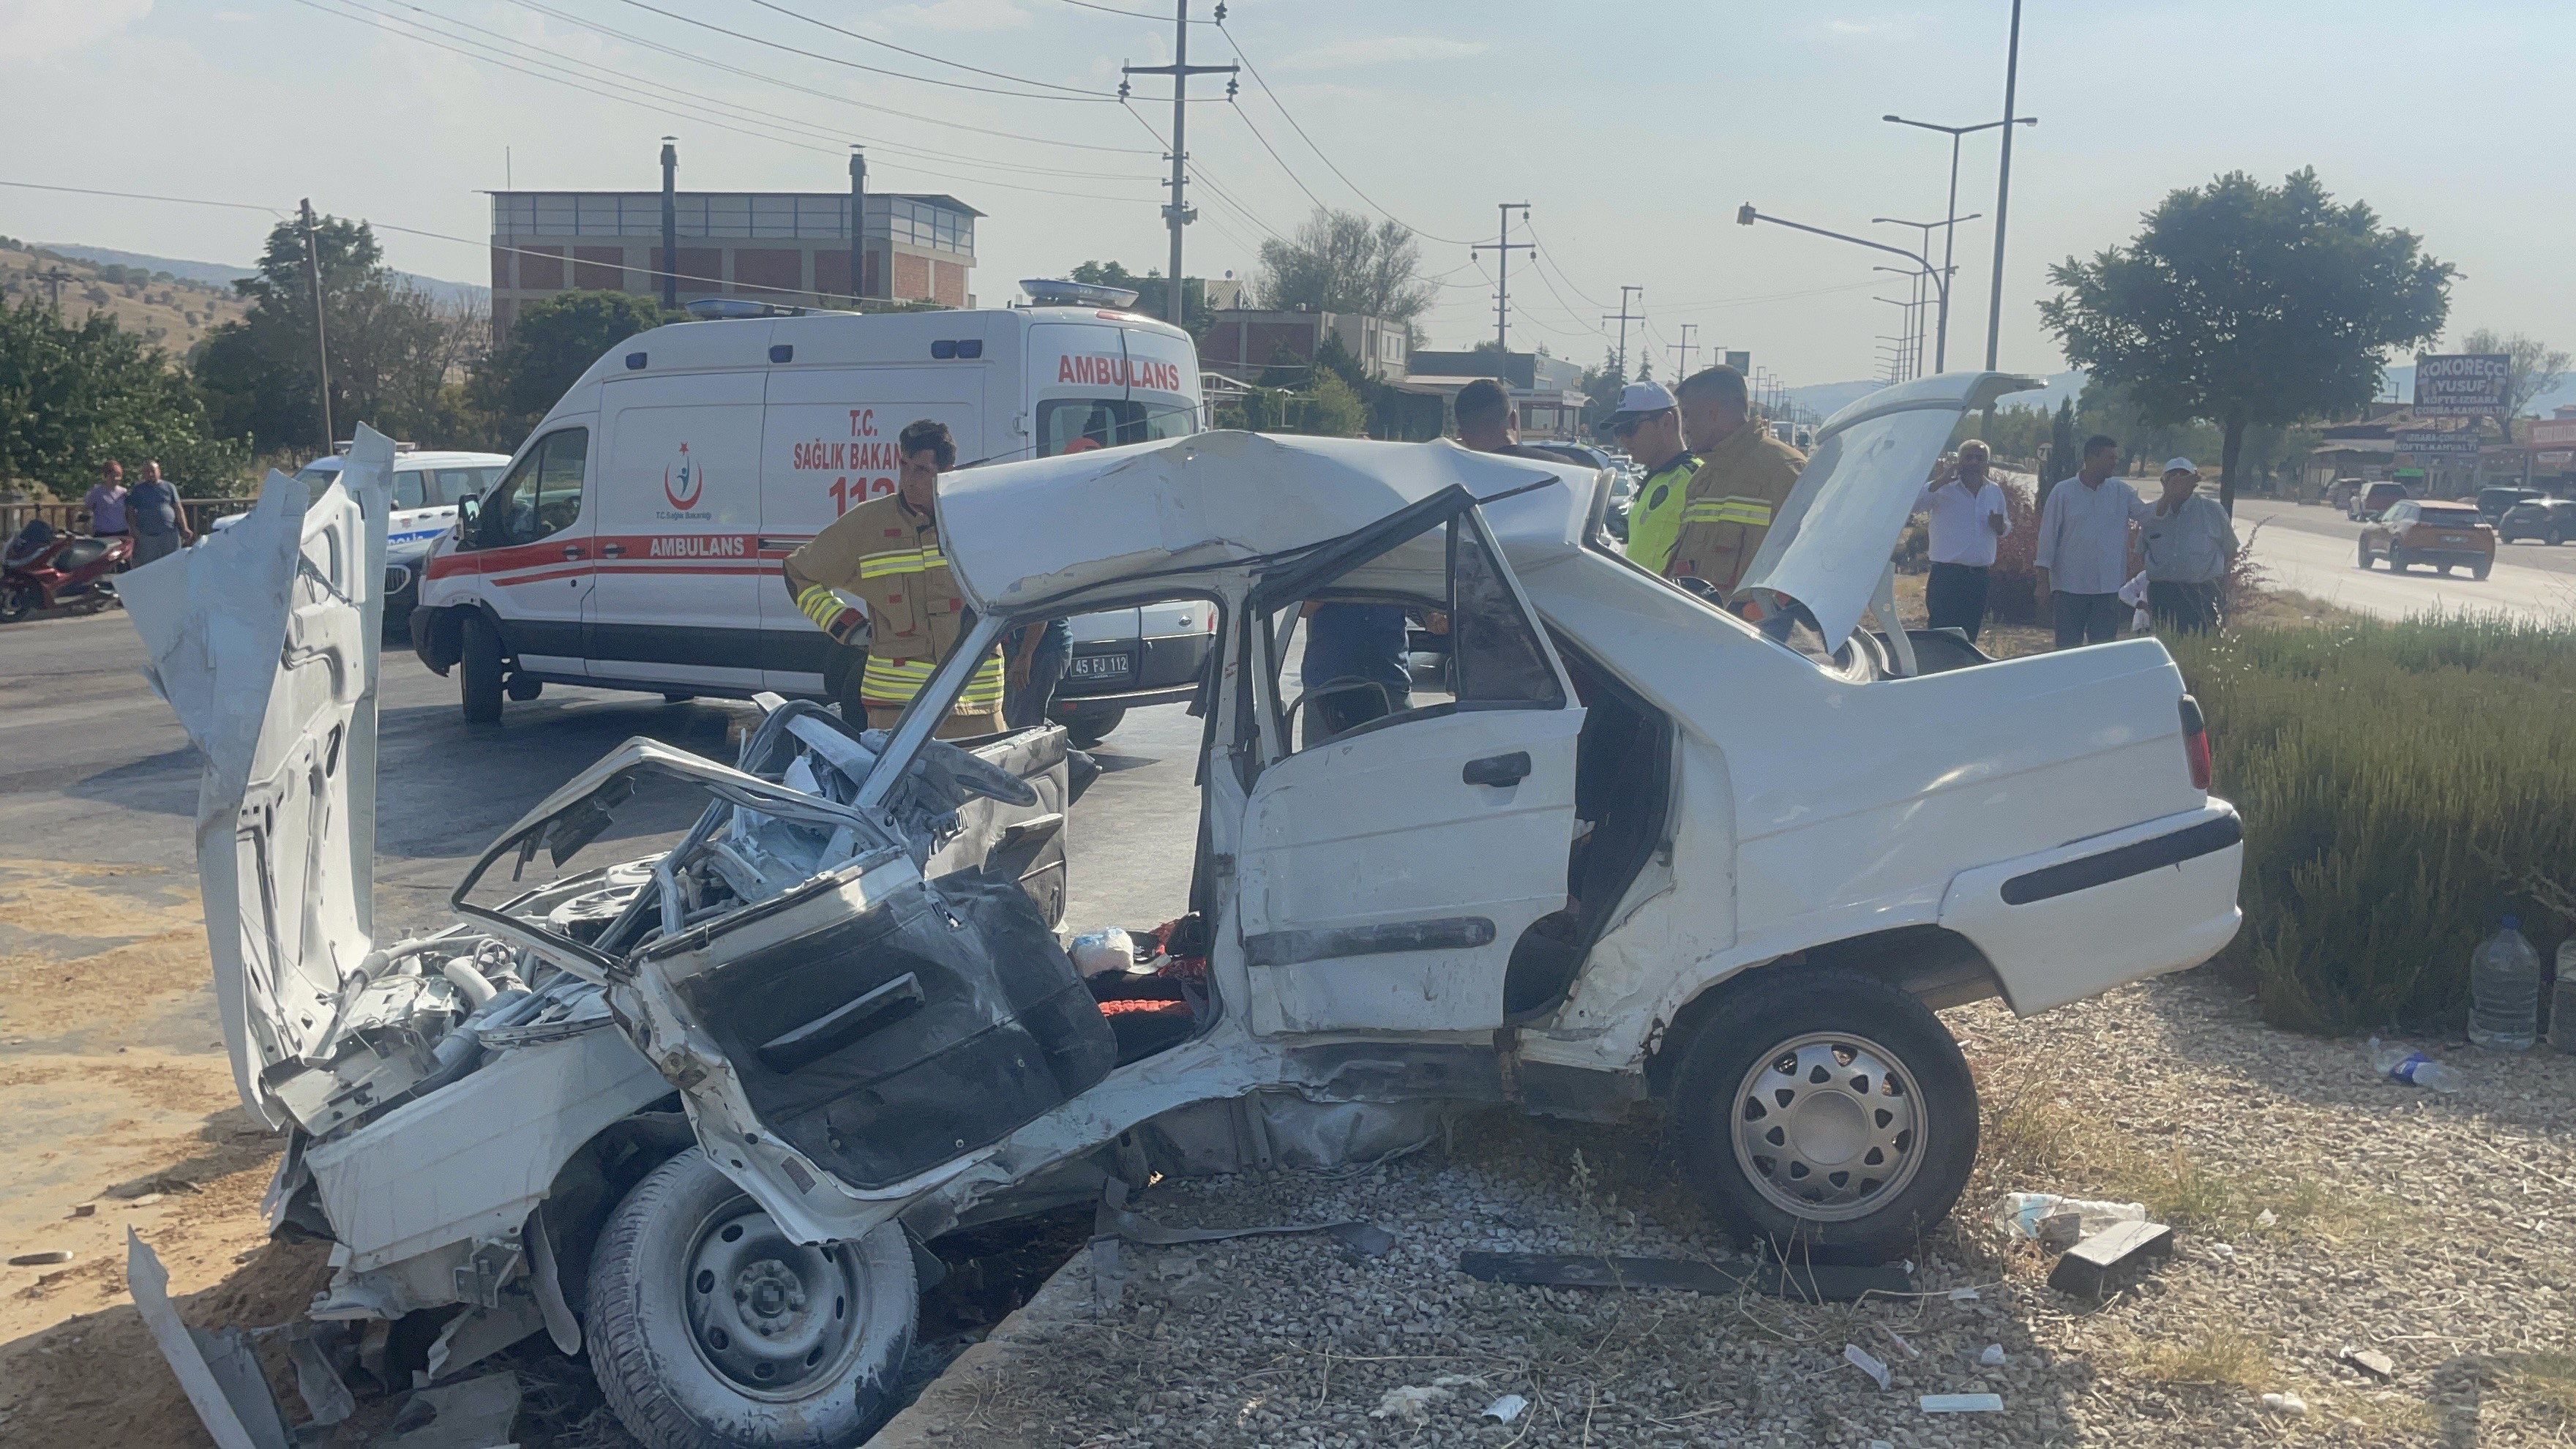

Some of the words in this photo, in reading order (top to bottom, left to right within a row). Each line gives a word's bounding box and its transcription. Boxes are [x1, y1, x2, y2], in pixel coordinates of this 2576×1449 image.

[1058, 354, 1180, 392] AMBULANS
[2436, 380, 2486, 392] YUSUF
[850, 409, 877, 436] T.C.
[794, 438, 845, 470] SAĞLIK
[850, 443, 901, 470] BAKAN
[650, 536, 744, 556] AMBULANS
[1076, 659, 1088, 674] 45
[1093, 658, 1105, 672] FJ
[1111, 656, 1127, 671] 112
